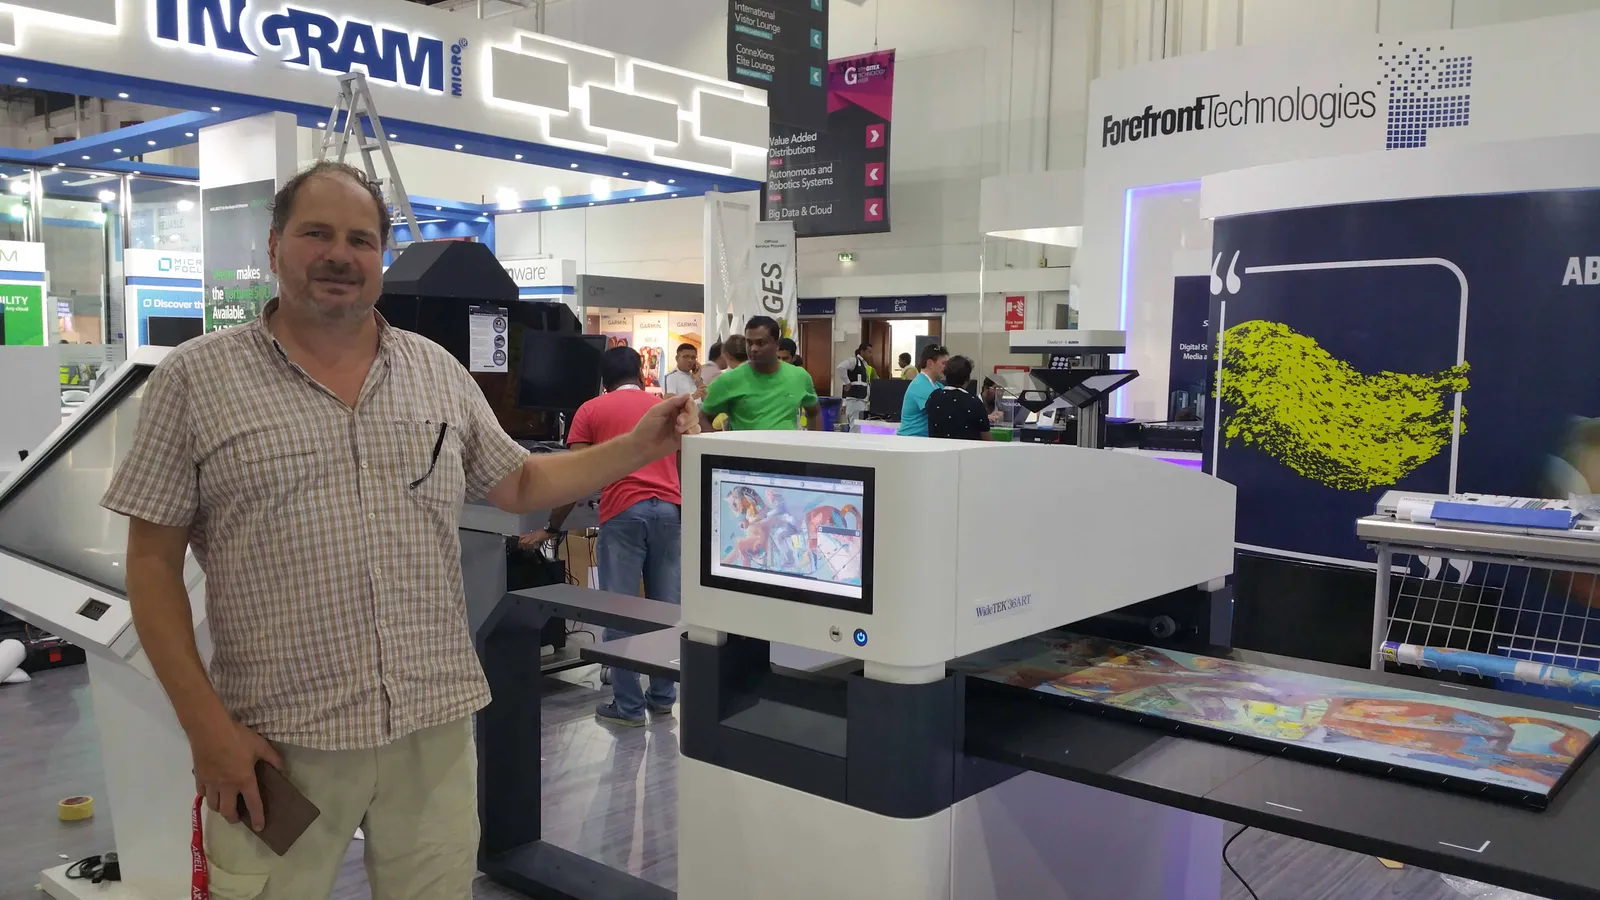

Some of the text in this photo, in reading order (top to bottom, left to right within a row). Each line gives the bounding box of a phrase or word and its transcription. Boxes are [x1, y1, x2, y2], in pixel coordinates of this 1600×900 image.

[734, 1, 776, 20] International
[734, 12, 756, 26] Visitor
[756, 18, 781, 35] Lounge
[157, 0, 444, 92] INGRAM
[735, 43, 775, 61] ConneXions
[736, 54, 750, 66] Elite
[751, 58, 776, 74] Lounge
[844, 66, 858, 85] G
[769, 131, 818, 146] Value Added
[769, 144, 816, 158] Distributions
[769, 162, 833, 179] Autonomous and
[768, 177, 834, 191] Robotics Systems
[768, 203, 833, 221] Big Data & Cloud
[174, 258, 202, 266] MICR
[1561, 256, 1600, 285] AB
[236, 265, 260, 280] makes
[212, 286, 224, 300] the
[761, 262, 784, 314] GES
[153, 299, 193, 309] Discover
[894, 304, 907, 312] Exit
[1180, 343, 1200, 352] Digital
[192, 844, 203, 873] AXIELL
